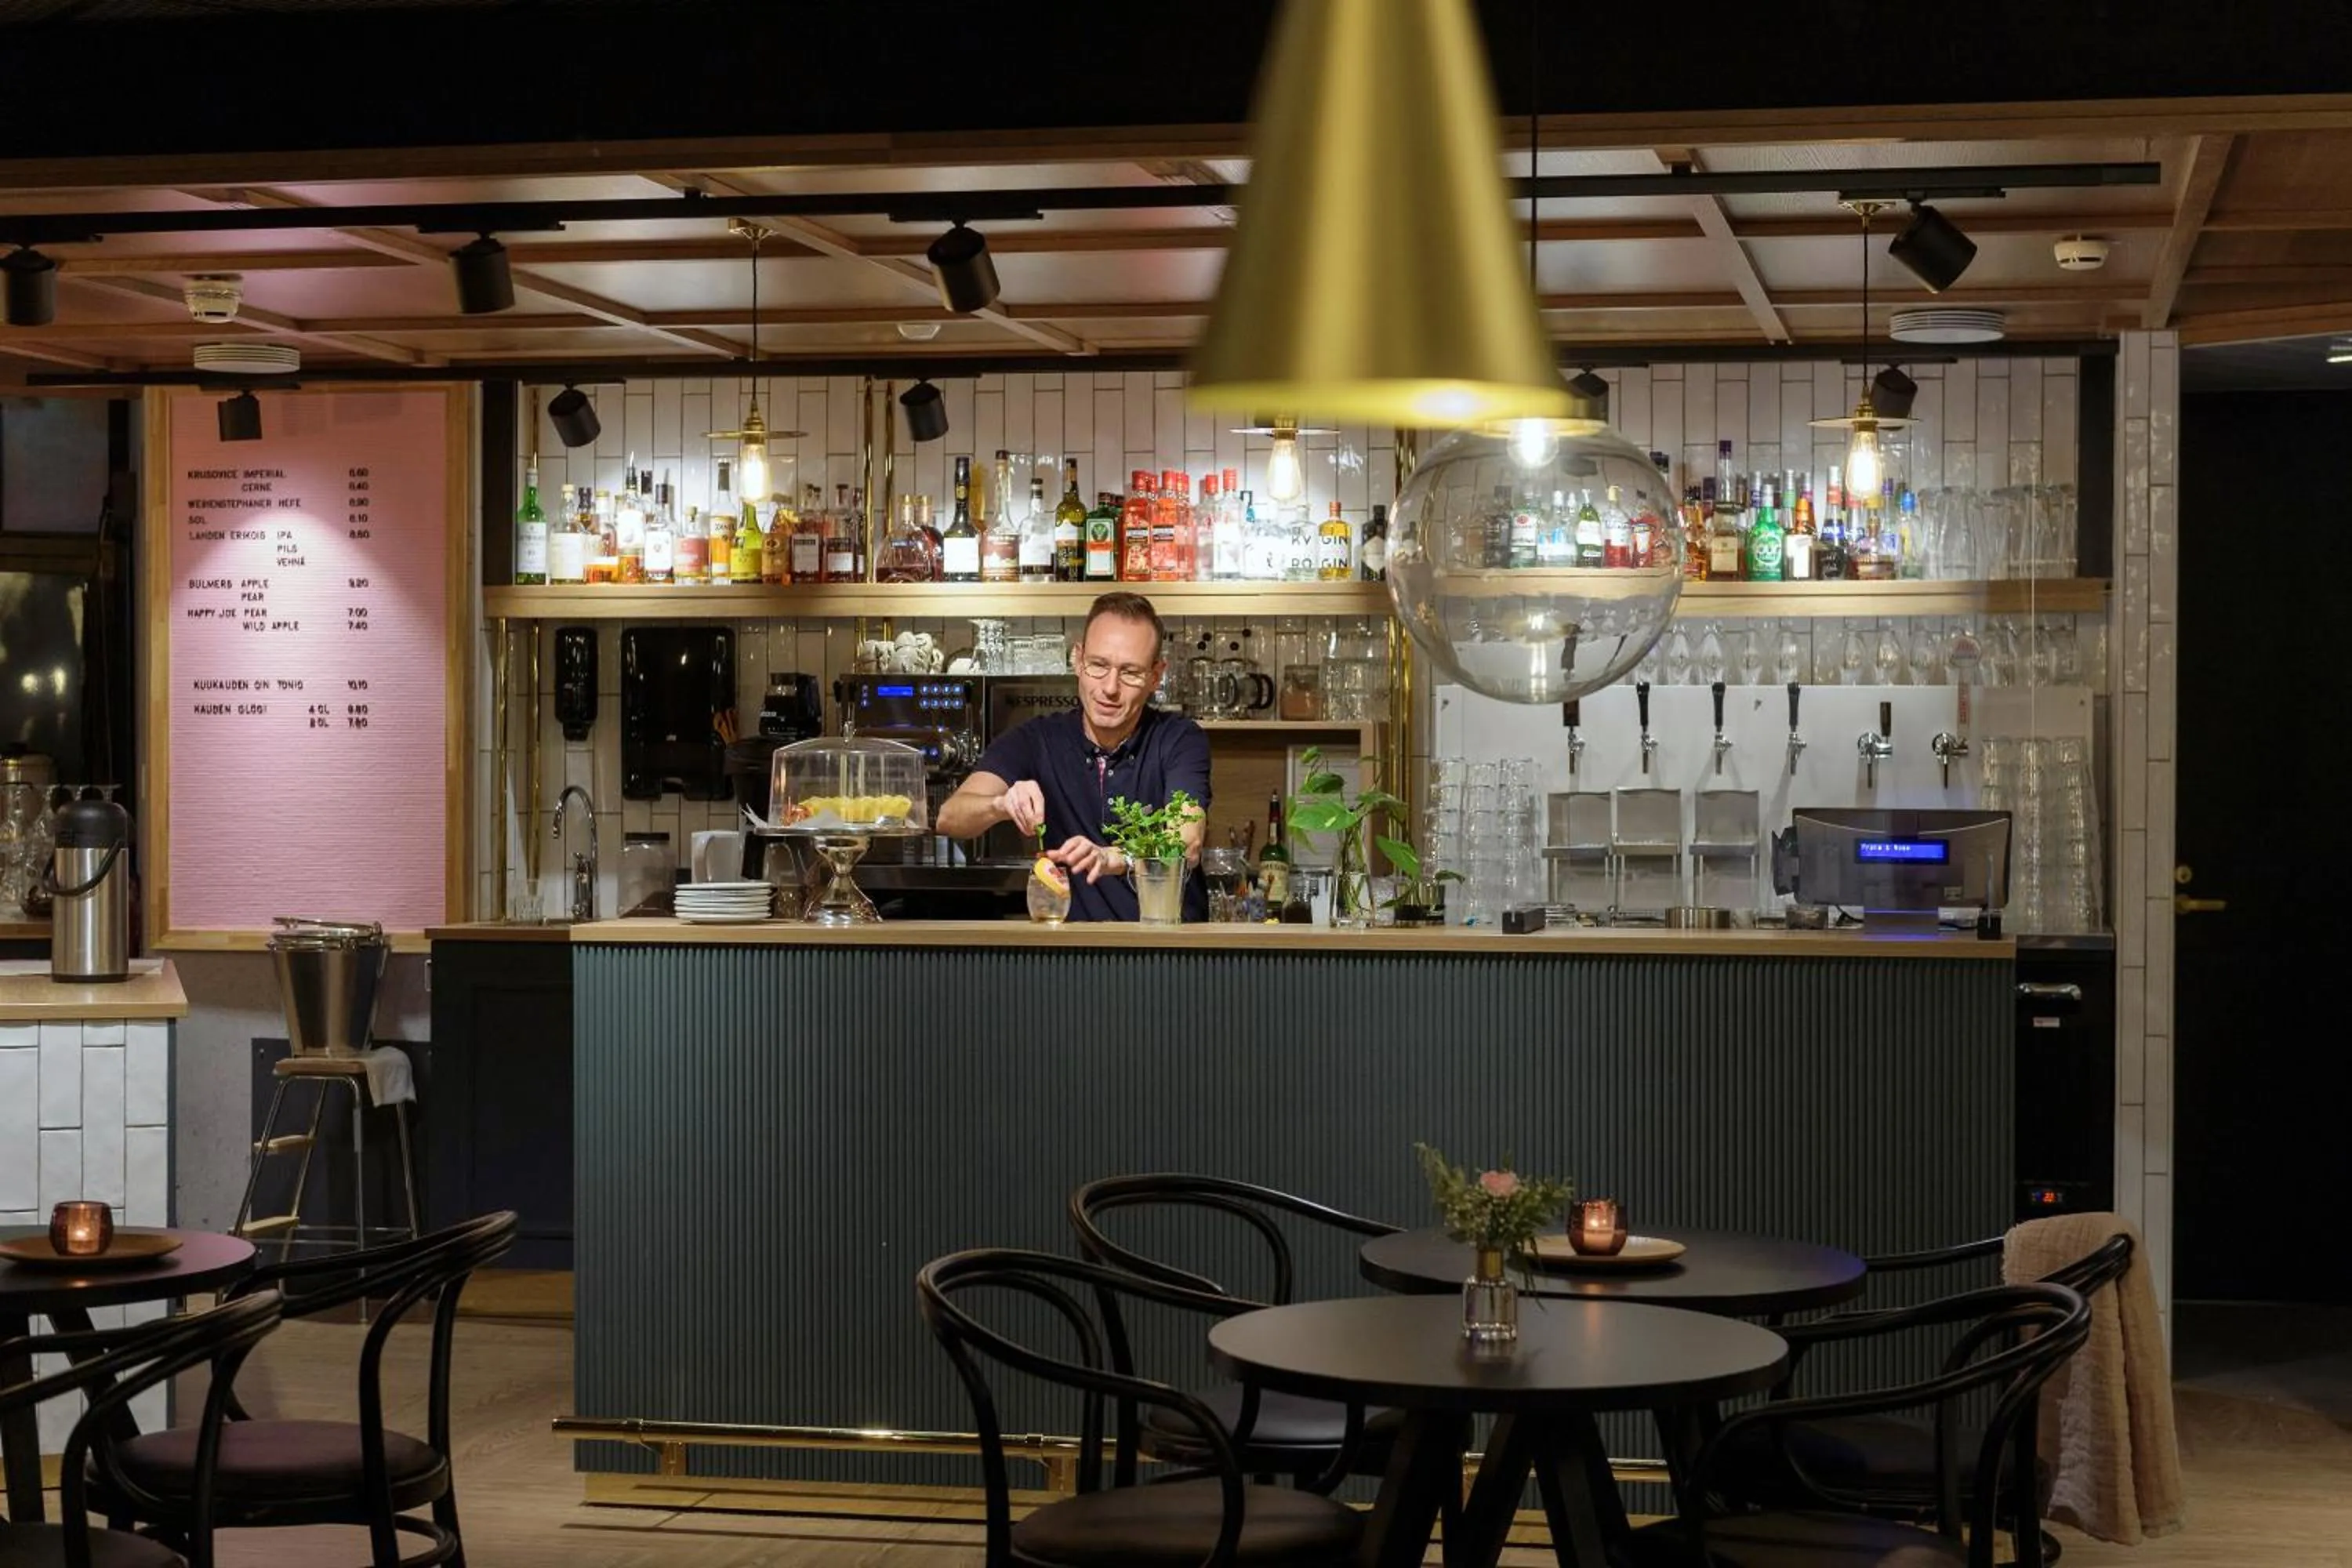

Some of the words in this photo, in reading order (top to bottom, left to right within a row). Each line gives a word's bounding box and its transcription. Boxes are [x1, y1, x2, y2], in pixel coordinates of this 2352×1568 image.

[278, 499, 301, 508] HEFE
[188, 516, 205, 524] SOL
[190, 531, 225, 539] LAHDEN
[230, 531, 265, 539] ERIKOIS
[278, 531, 292, 539] IPA
[278, 544, 296, 553] PILS
[189, 579, 232, 588] BULMERS
[241, 579, 268, 588] APPLE
[241, 593, 263, 601] PEAR
[188, 609, 215, 618] HAPPY
[243, 622, 266, 630] WILD
[273, 622, 299, 630] APPLE
[194, 681, 248, 689] KUUKAUDEN
[194, 706, 231, 714] KAUDEN
